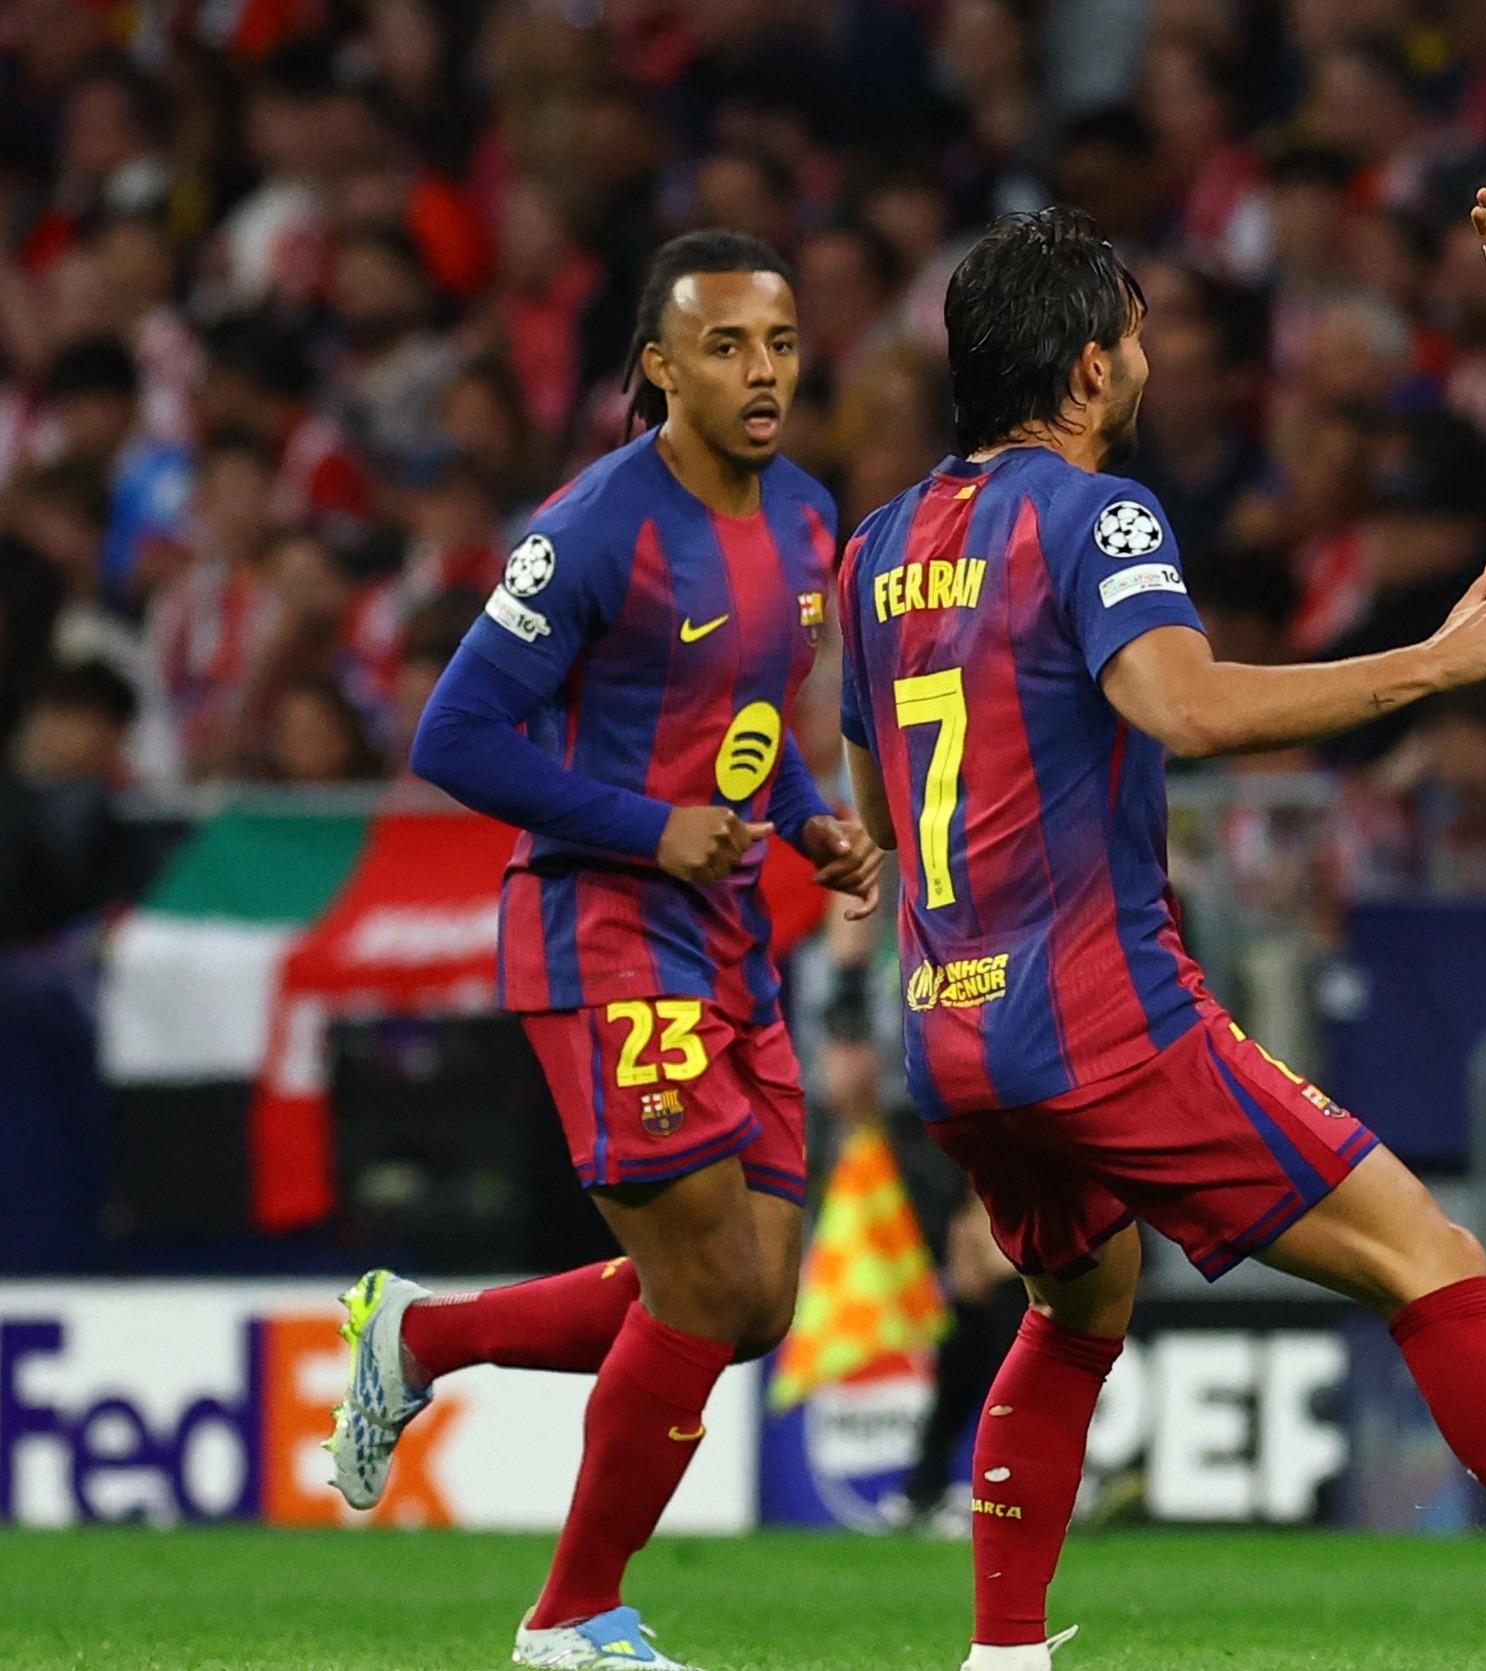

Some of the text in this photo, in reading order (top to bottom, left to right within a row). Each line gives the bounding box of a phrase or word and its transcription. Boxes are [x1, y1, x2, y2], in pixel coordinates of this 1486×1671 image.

[875, 558, 987, 623] FERRAN
[894, 667, 967, 909] 7
[607, 1000, 708, 1087] 23
